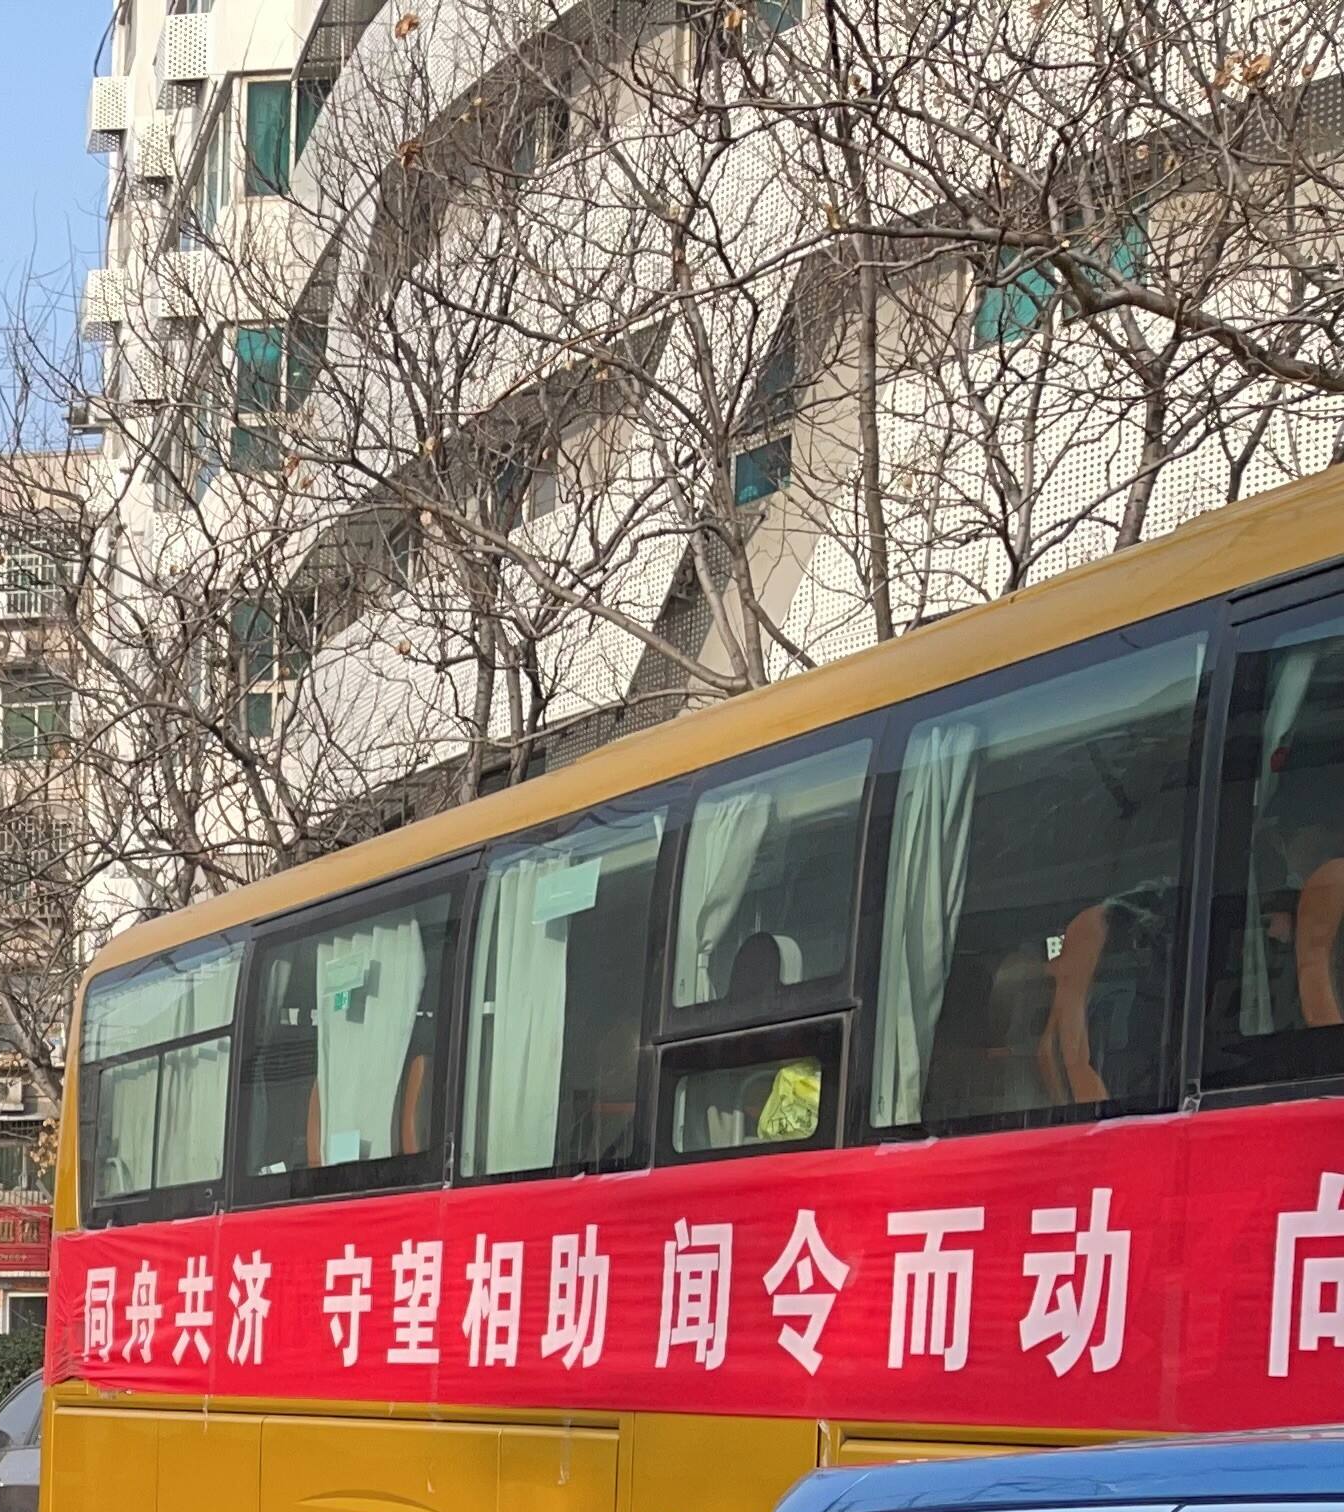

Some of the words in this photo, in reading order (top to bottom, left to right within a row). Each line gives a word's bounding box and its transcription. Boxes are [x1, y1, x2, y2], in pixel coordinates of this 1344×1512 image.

[82, 1250, 271, 1366] 同舟共济
[322, 1225, 609, 1369] 守望相助
[655, 1187, 1131, 1377] 闻令而动
